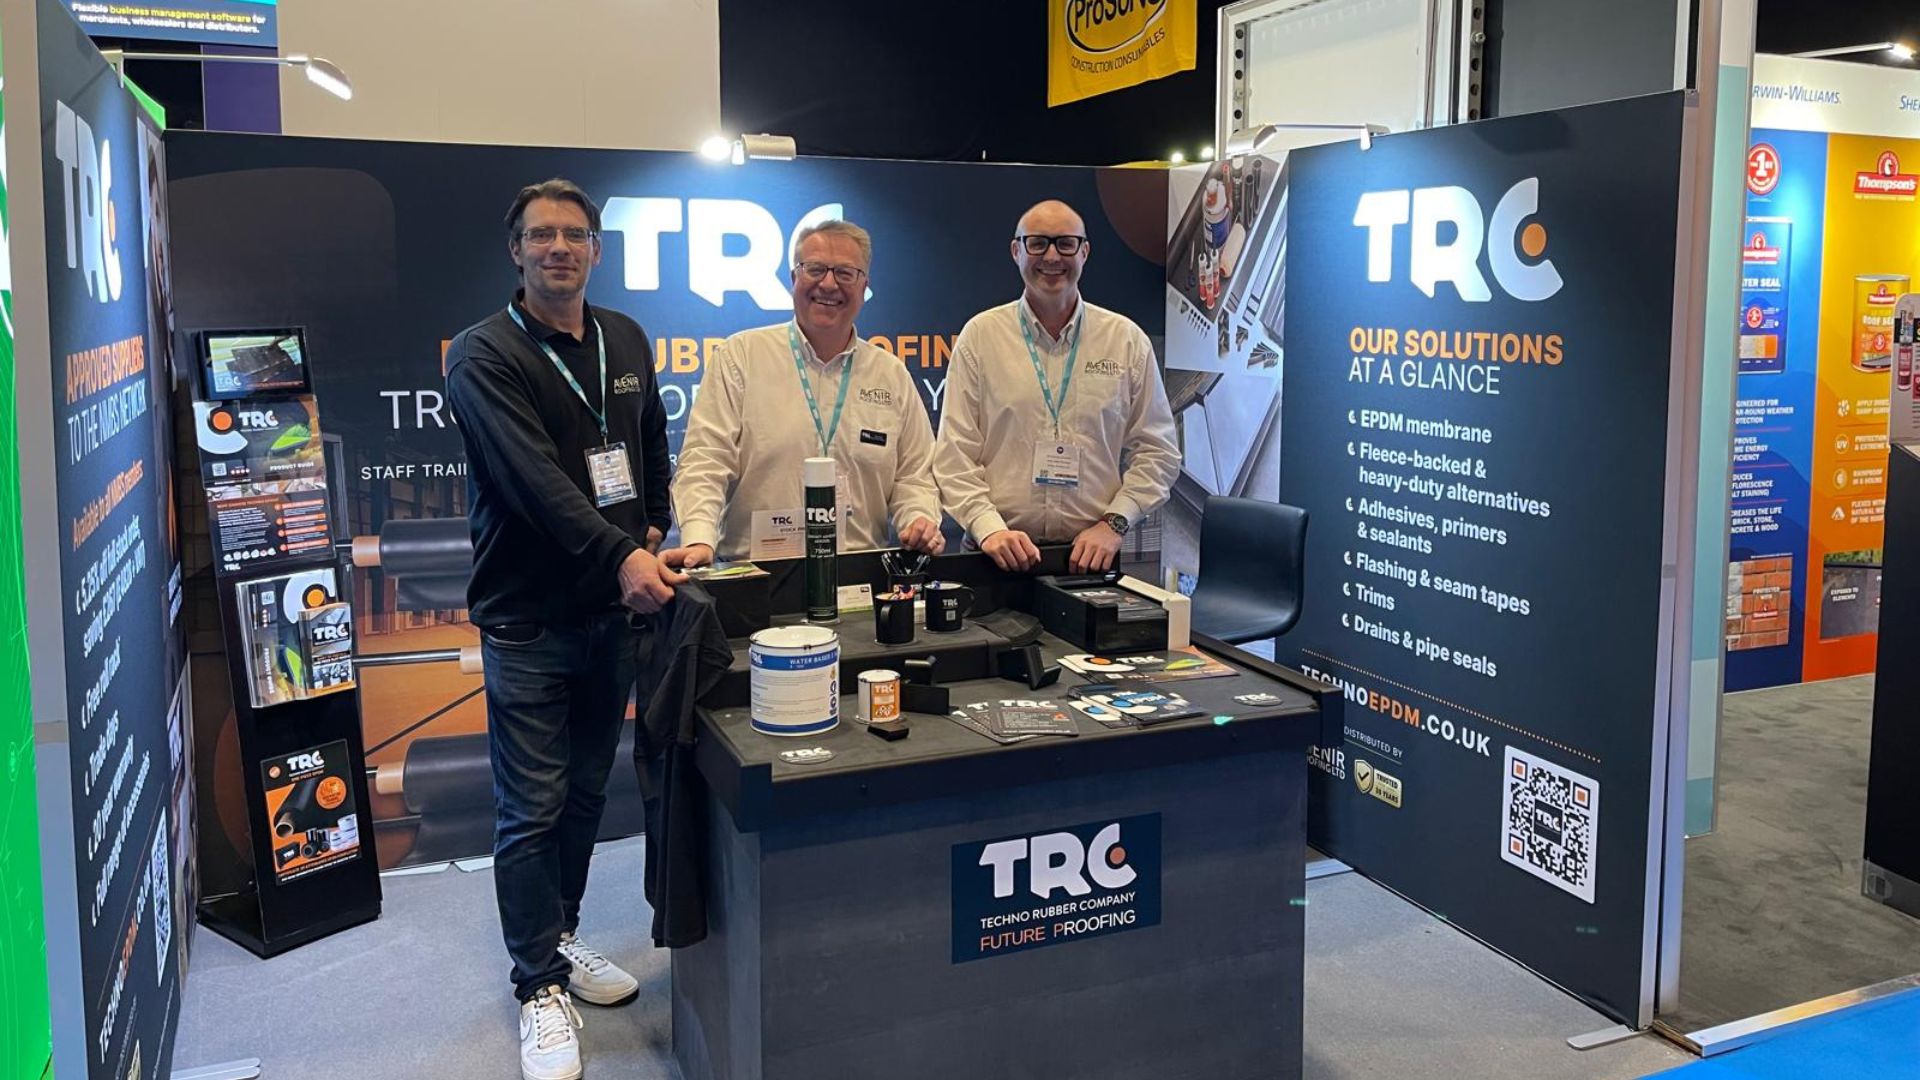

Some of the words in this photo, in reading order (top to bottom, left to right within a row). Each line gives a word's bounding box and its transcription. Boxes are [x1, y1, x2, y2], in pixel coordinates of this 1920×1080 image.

[72, 3, 108, 13] Flexible
[109, 4, 150, 16] business
[150, 8, 210, 21] management
[212, 12, 252, 22] software
[252, 14, 266, 24] for
[79, 14, 130, 26] merchants,
[132, 16, 186, 29] wholesalers
[187, 20, 204, 30] and
[206, 20, 260, 33] distributors.
[1072, 55, 1114, 74] CONSTRUCTION
[1115, 28, 1166, 70] CONSUMABLES
[1858, 175, 1916, 192] Thompson's
[56, 99, 122, 303] TRC
[1353, 177, 1564, 302] TRC
[1760, 278, 1781, 287] SEAL
[1350, 327, 1398, 355] OUR
[1404, 329, 1564, 366] SOLUTIONS
[66, 344, 112, 405] APPROVED
[112, 335, 144, 383] SUPPLIERS
[1349, 357, 1374, 383] AT
[1378, 359, 1394, 386] A
[1400, 360, 1500, 395] GLANCE
[1736, 400, 1766, 408] GINEERED
[1766, 398, 1778, 406] FOR
[1766, 406, 1794, 414] WEATHER
[68, 413, 82, 466] TO
[82, 404, 98, 456] THE
[120, 378, 147, 433] NETWORK
[238, 410, 279, 428] TRC
[1360, 409, 1404, 432] EPDM
[1406, 416, 1492, 444] membrane
[1735, 416, 1764, 424] OTECTION
[1746, 445, 1768, 453] ENERGY
[1836, 440, 1848, 448] UV
[1360, 442, 1471, 477] Fleece-backed
[1475, 459, 1487, 479] &
[1734, 454, 1760, 462] FICIENCY
[361, 464, 416, 480] STAFF
[1359, 466, 1444, 501] heavy-duty
[1447, 482, 1551, 518] alternatives
[1732, 480, 1774, 489] FLORESCENCE
[772, 516, 793, 525] TRC
[1358, 497, 1438, 534] Adhesives,
[1442, 516, 1508, 546] primers
[1770, 506, 1782, 514] LIFE
[1357, 522, 1368, 539] &
[1370, 526, 1432, 554] sealants
[1731, 526, 1754, 534] NCRETE
[1760, 524, 1779, 532] WOOD
[1356, 552, 1417, 588] Flashing
[1420, 569, 1430, 588] &
[1434, 576, 1477, 600] seam
[1480, 585, 1530, 616] tapes
[1356, 583, 1396, 611] Trims
[314, 624, 348, 640] TRC
[1354, 614, 1400, 645] Drains
[1402, 631, 1413, 650] &
[1416, 637, 1450, 662] pipe
[1452, 650, 1498, 678] seals
[1116, 656, 1165, 664] TRC
[875, 684, 894, 694] TRC
[86, 682, 100, 724] Free
[1344, 726, 1391, 753] DISTRIBUTED
[1392, 747, 1403, 758] BY
[287, 750, 324, 771] TRC
[1309, 745, 1345, 770] ENIR
[1376, 773, 1398, 789] TRUSTED
[1382, 789, 1399, 804] YEARS
[101, 788, 113, 841] year
[1536, 808, 1562, 832] TRC
[978, 822, 1137, 899] TRC
[980, 910, 1030, 929] TECHNO
[1032, 902, 1076, 920] RUBBER
[1080, 892, 1136, 911] COMPANY
[980, 926, 1046, 952] FUTURE
[1054, 909, 1136, 938] PROOFING
